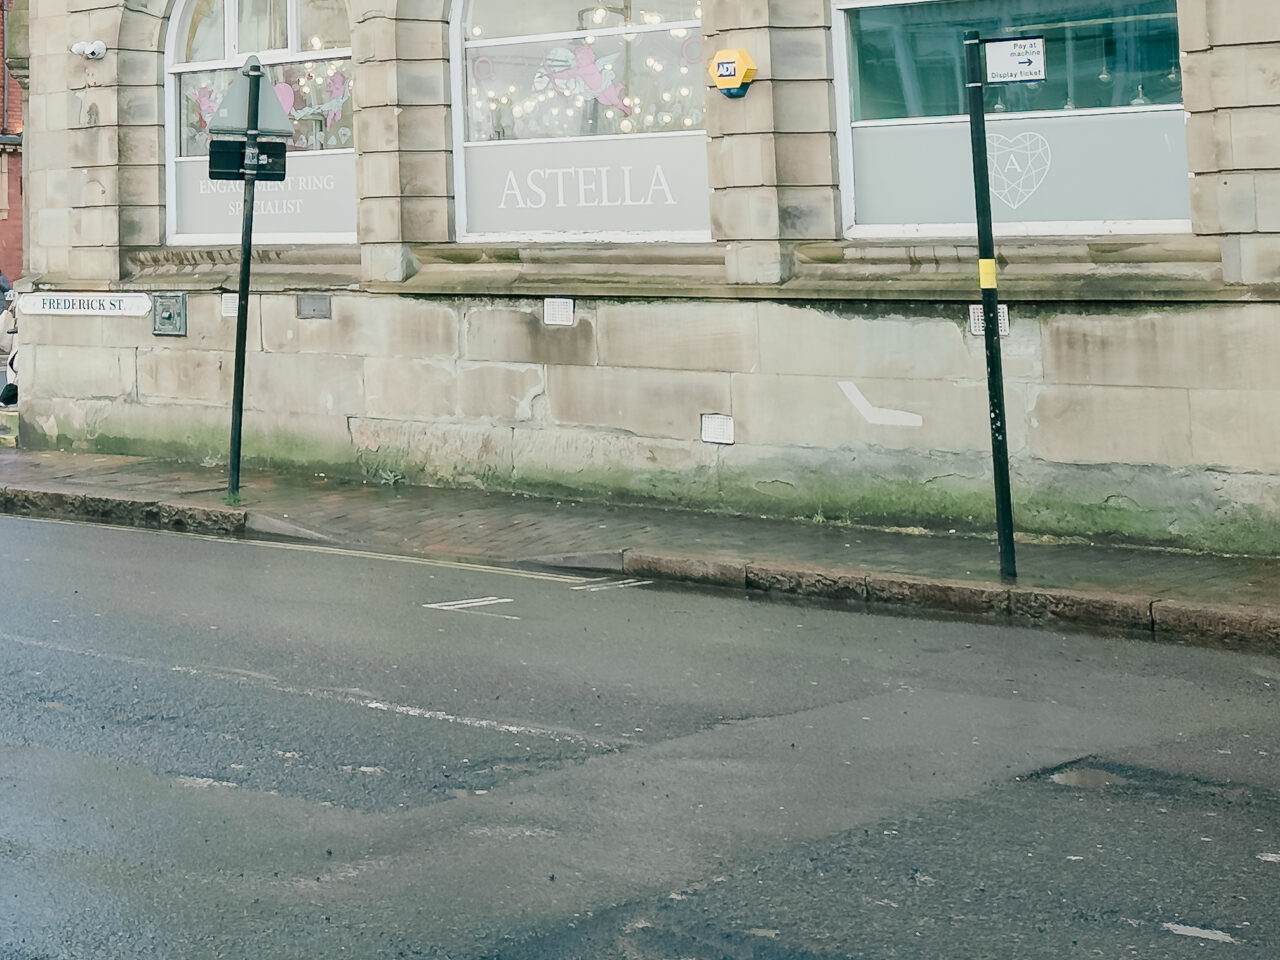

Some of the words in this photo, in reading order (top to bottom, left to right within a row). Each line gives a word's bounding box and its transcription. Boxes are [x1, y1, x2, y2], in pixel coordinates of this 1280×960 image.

[717, 62, 736, 76] ADT
[991, 71, 1018, 79] Display
[1004, 153, 1023, 173] A
[199, 176, 294, 194] ENGAGMENT
[298, 175, 335, 191] RING
[497, 164, 678, 209] ASTELLA
[228, 199, 304, 216] SPCIALIST
[41, 298, 106, 311] FREDERICK
[109, 298, 126, 311] ST.
